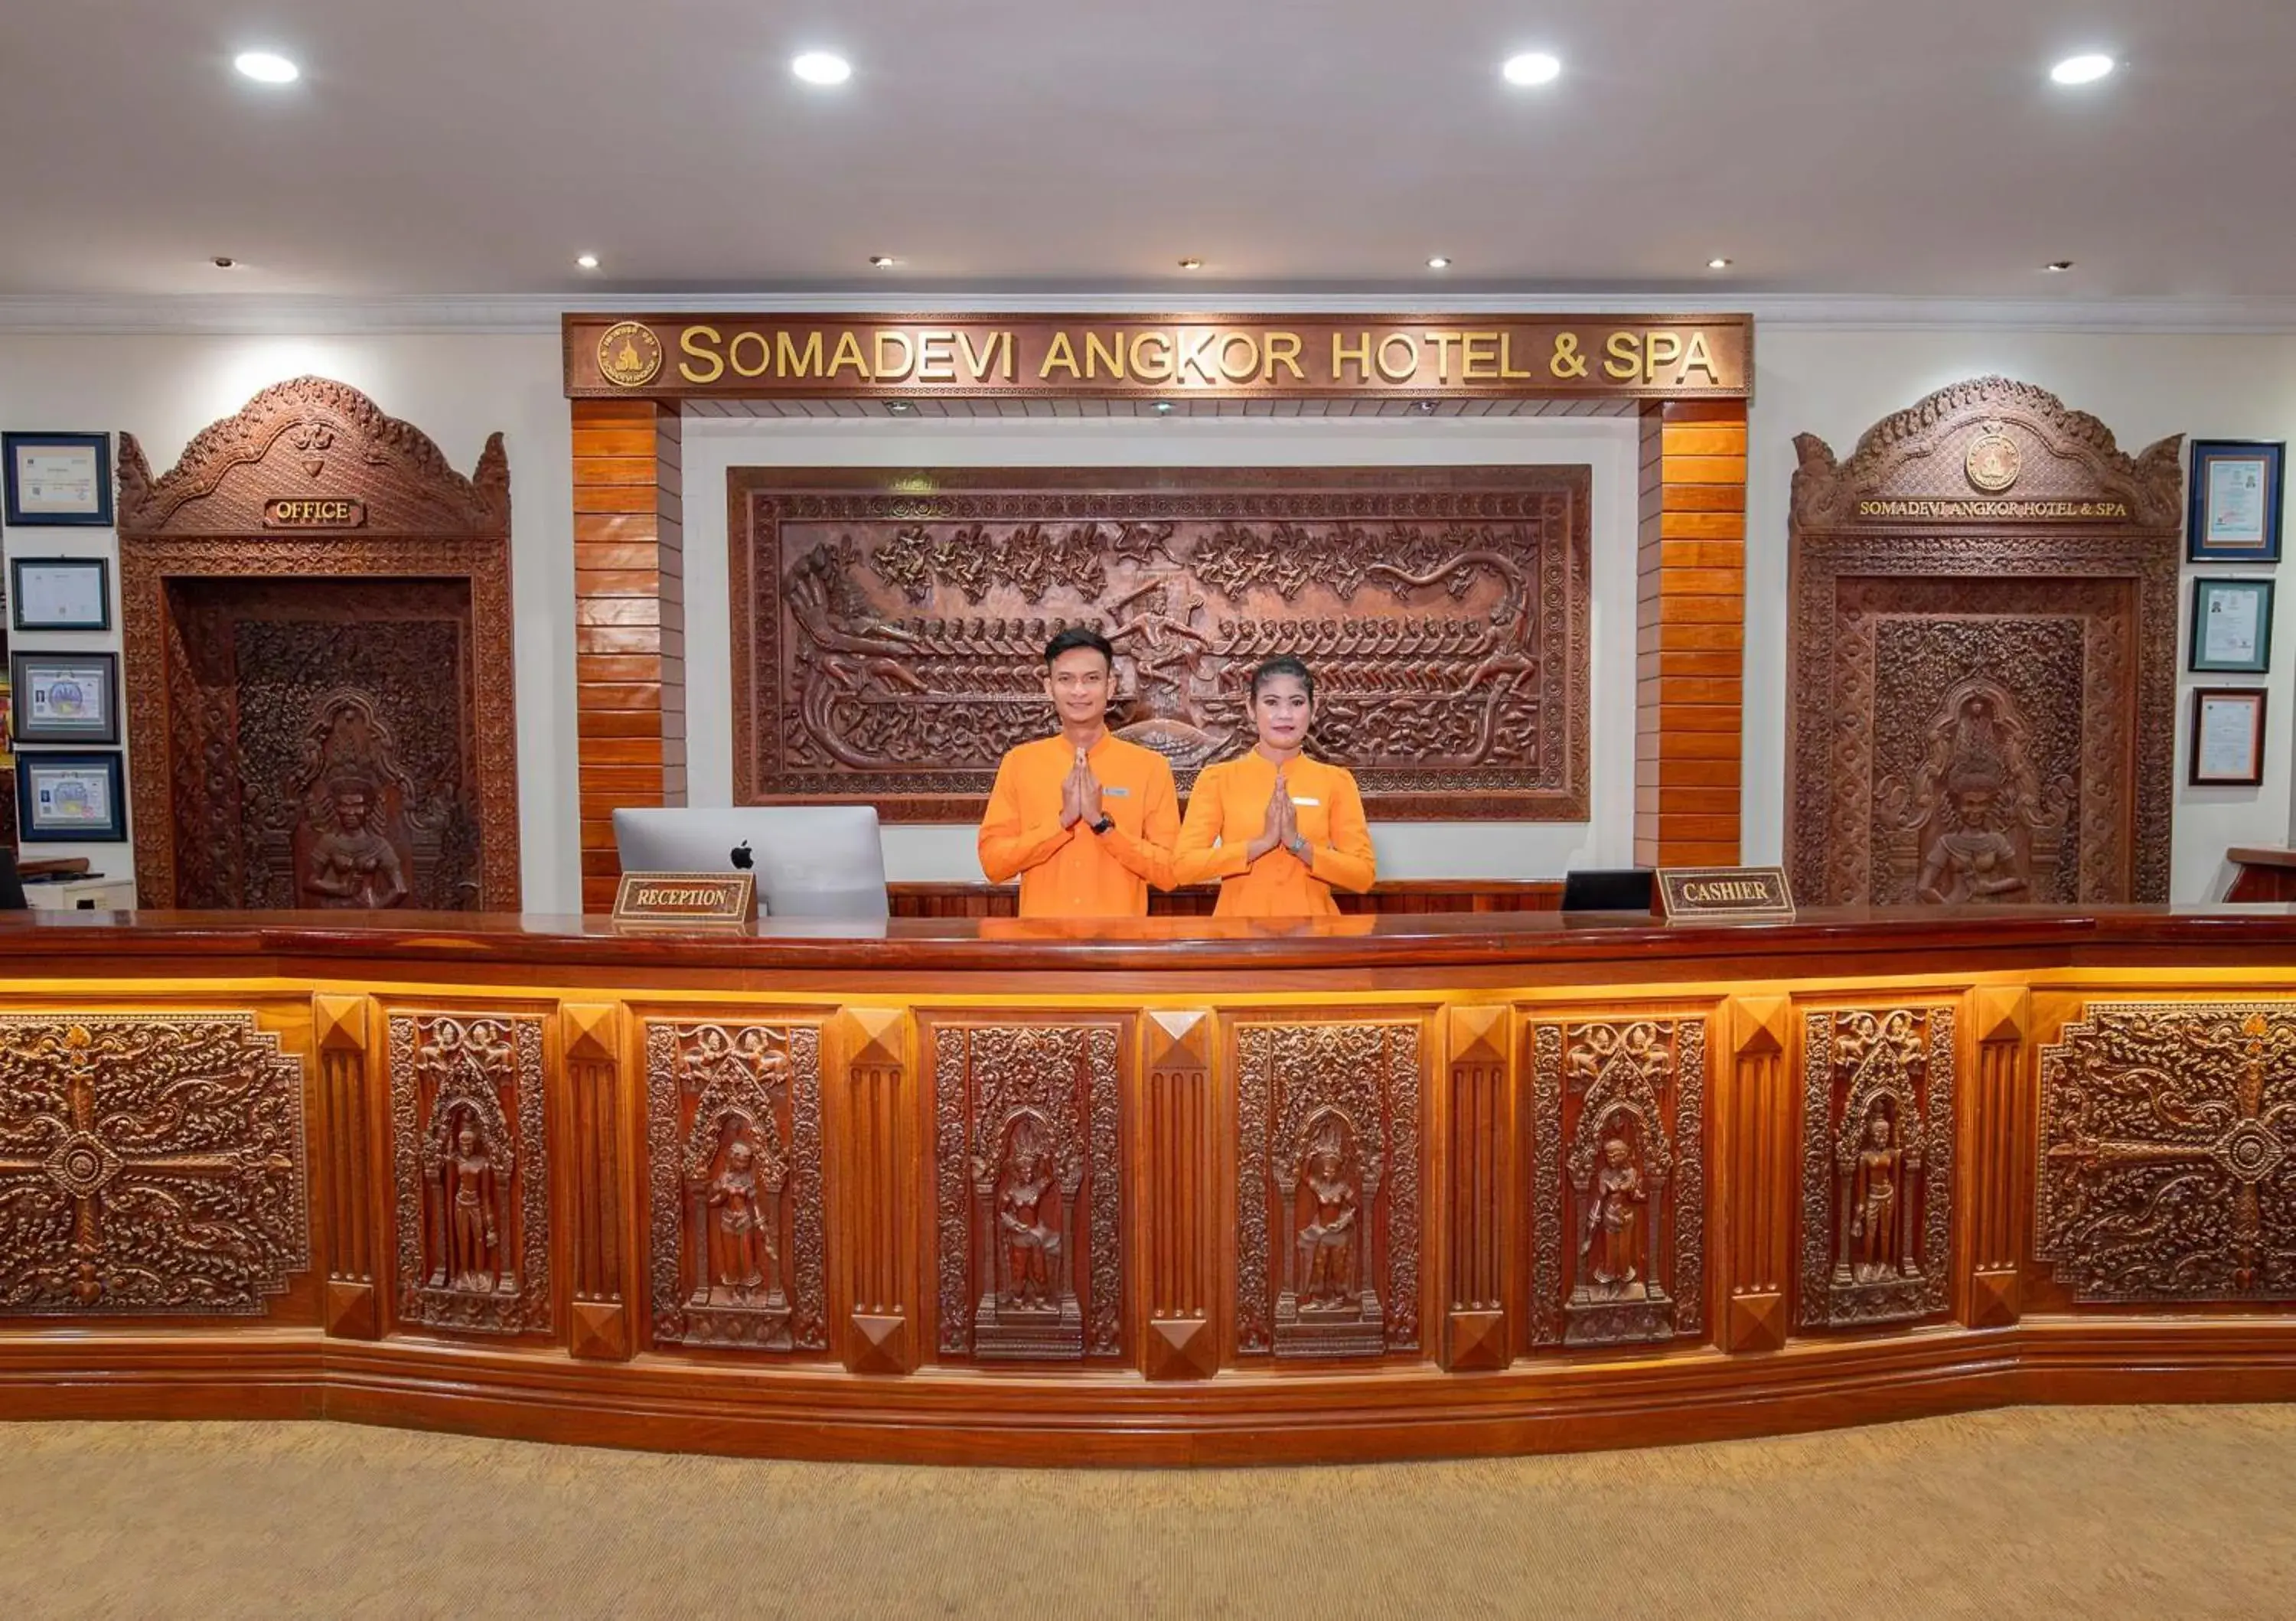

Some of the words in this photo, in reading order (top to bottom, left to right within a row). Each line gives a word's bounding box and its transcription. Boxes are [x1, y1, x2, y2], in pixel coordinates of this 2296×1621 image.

[678, 325, 1013, 383] SOMADEVI
[1039, 331, 1304, 379] ANGKOR
[1332, 331, 1531, 379] HOTEL
[1550, 331, 1587, 378] &
[1603, 331, 1719, 381] SPA
[276, 501, 349, 518] OFFICE
[1860, 501, 1945, 515] SOMADEVI
[1951, 501, 2018, 515] ANGKOR
[2024, 503, 2076, 515] HOTEL
[2080, 503, 2092, 515] &
[2096, 503, 2126, 516] SPA
[637, 889, 727, 906] RECEPTION
[1684, 881, 1769, 901] CASHIER
